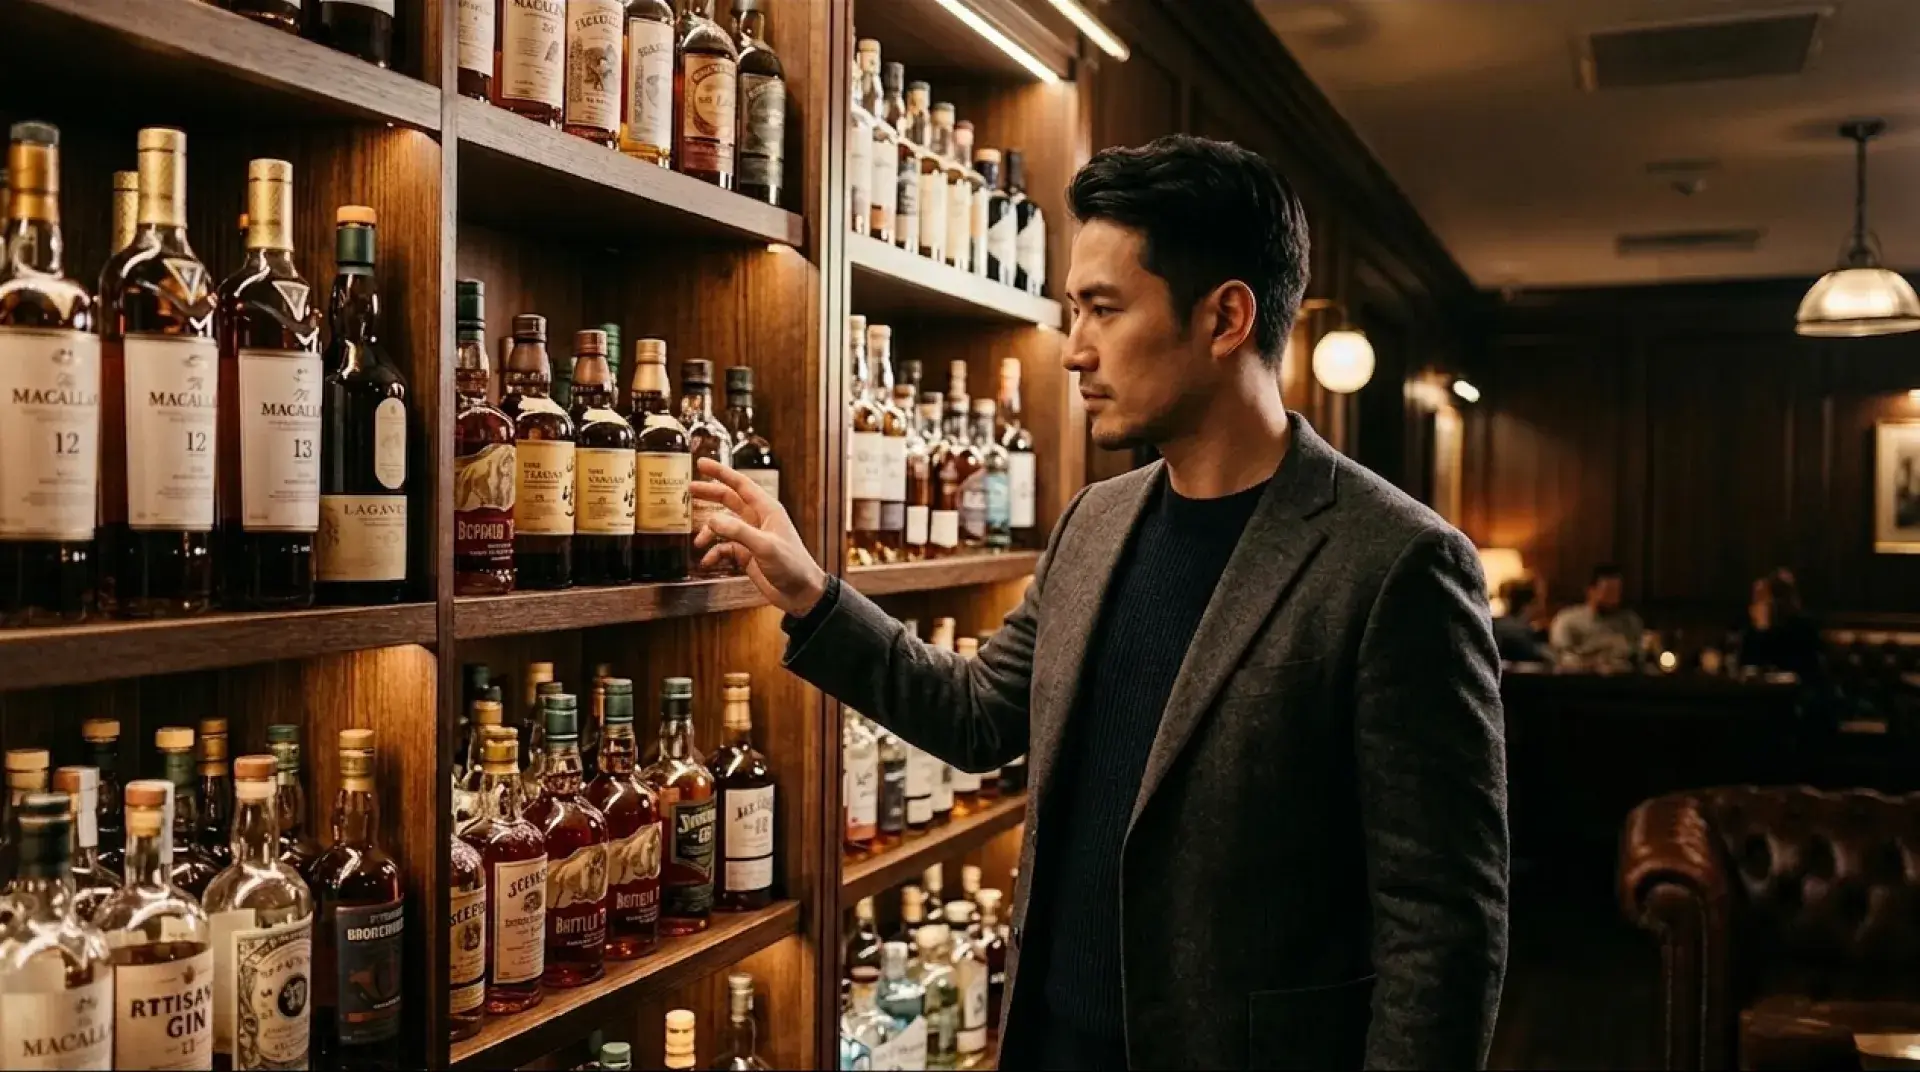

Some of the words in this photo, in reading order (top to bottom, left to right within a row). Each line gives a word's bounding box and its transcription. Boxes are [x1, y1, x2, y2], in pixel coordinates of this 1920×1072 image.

[55, 431, 80, 454] 12
[185, 432, 206, 452] 12
[293, 439, 313, 458] 13
[166, 1009, 206, 1037] GIN
